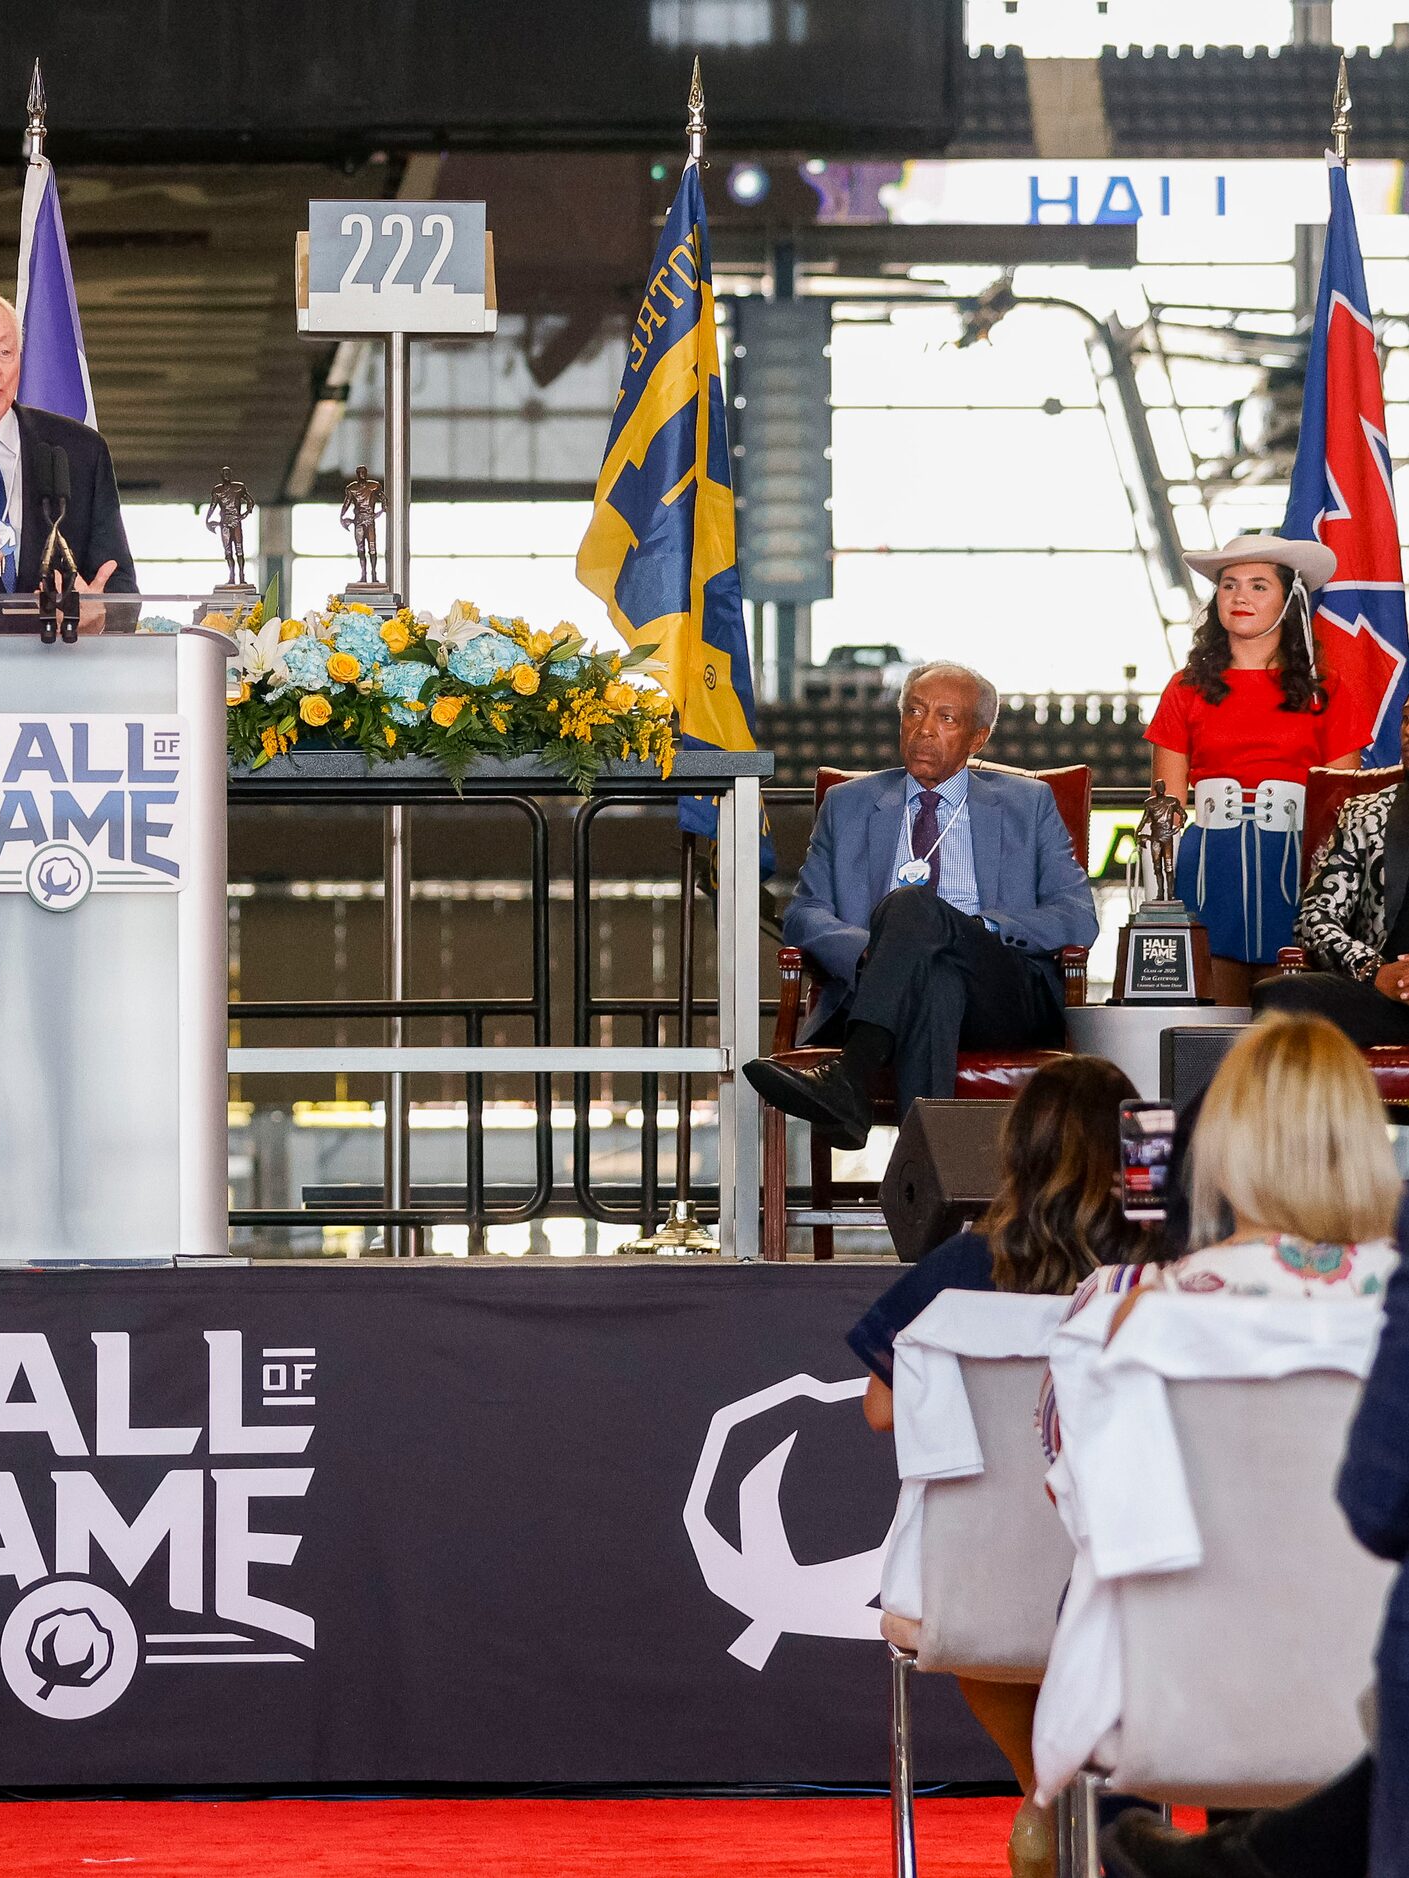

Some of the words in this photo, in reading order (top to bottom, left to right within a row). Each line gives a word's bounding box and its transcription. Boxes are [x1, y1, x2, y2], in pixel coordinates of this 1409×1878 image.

[339, 213, 455, 294] 222
[154, 740, 180, 753] OF
[1143, 939, 1177, 948] HALL
[1143, 949, 1177, 961] FAME
[263, 1363, 316, 1391] OF
